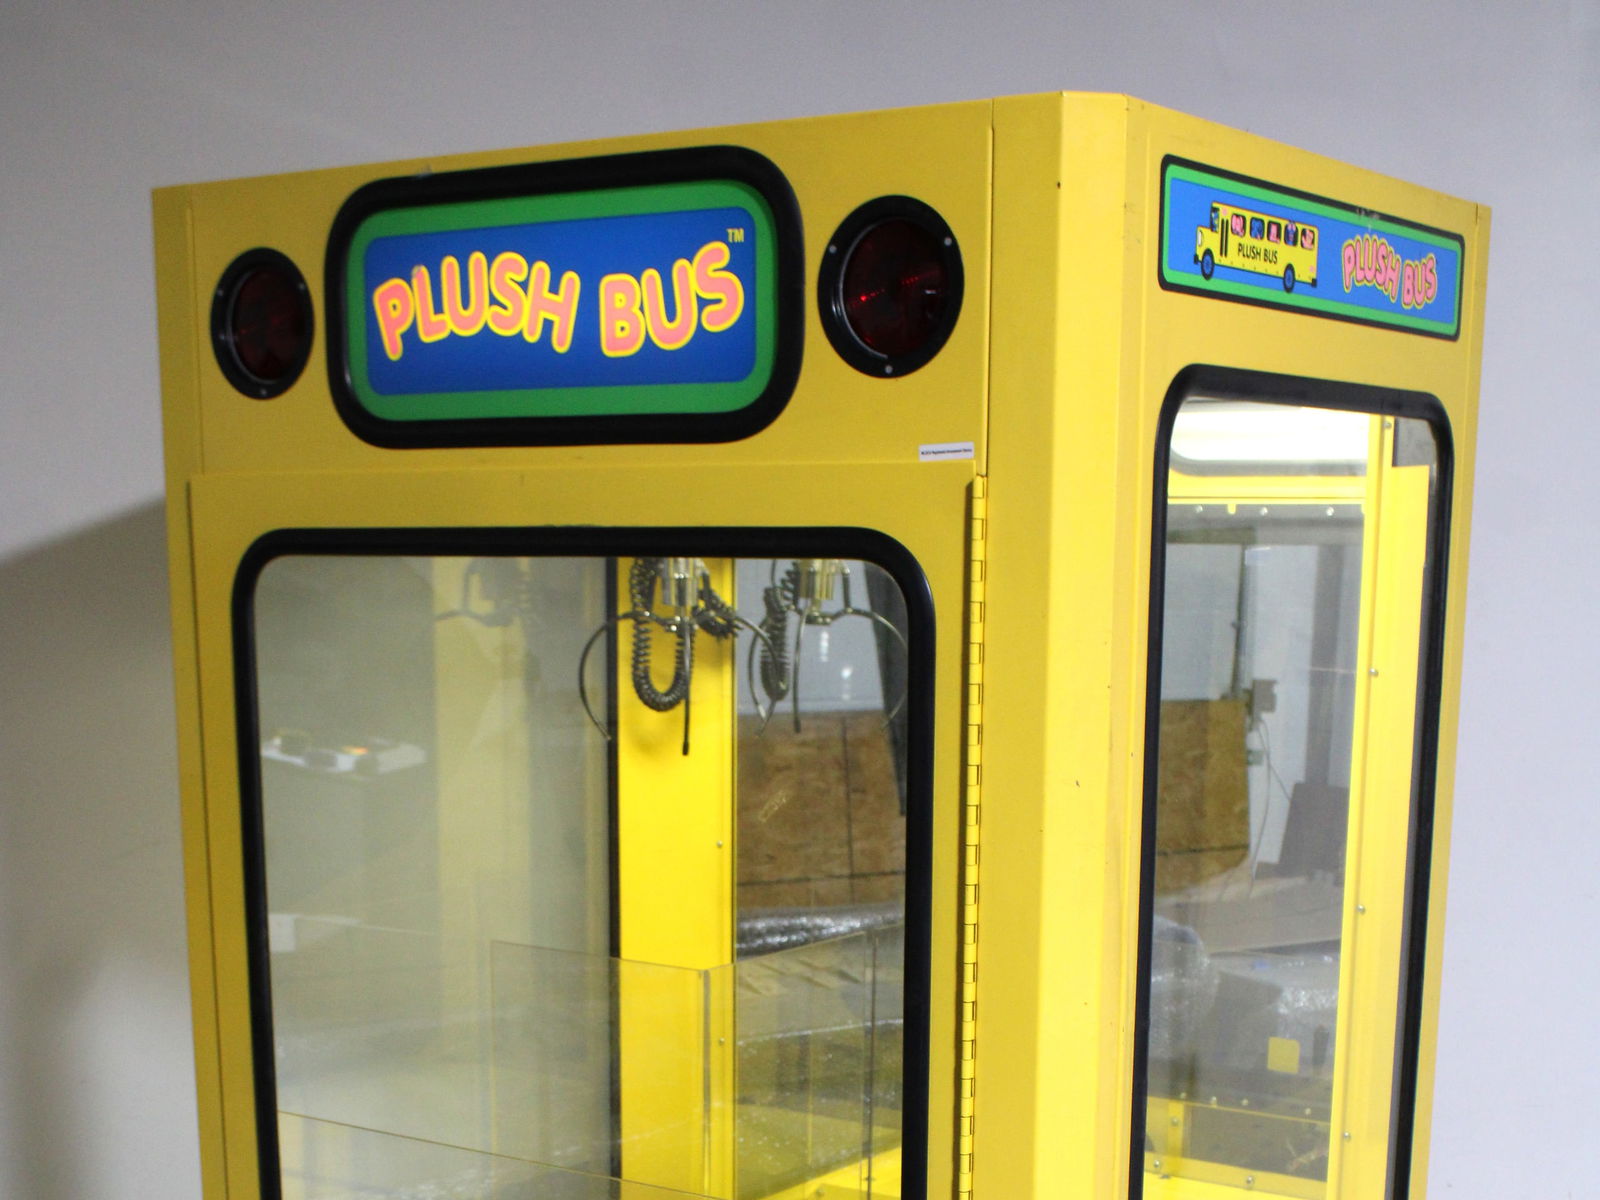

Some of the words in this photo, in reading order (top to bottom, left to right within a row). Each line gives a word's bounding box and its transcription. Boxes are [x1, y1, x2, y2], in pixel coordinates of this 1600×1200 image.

[1237, 243, 1262, 262] PLUSH
[1263, 248, 1278, 265] BUS
[1342, 234, 1401, 303] PLUSH
[1401, 252, 1437, 310] BUS
[373, 251, 581, 361] PLUSH
[600, 241, 745, 357] BUS
